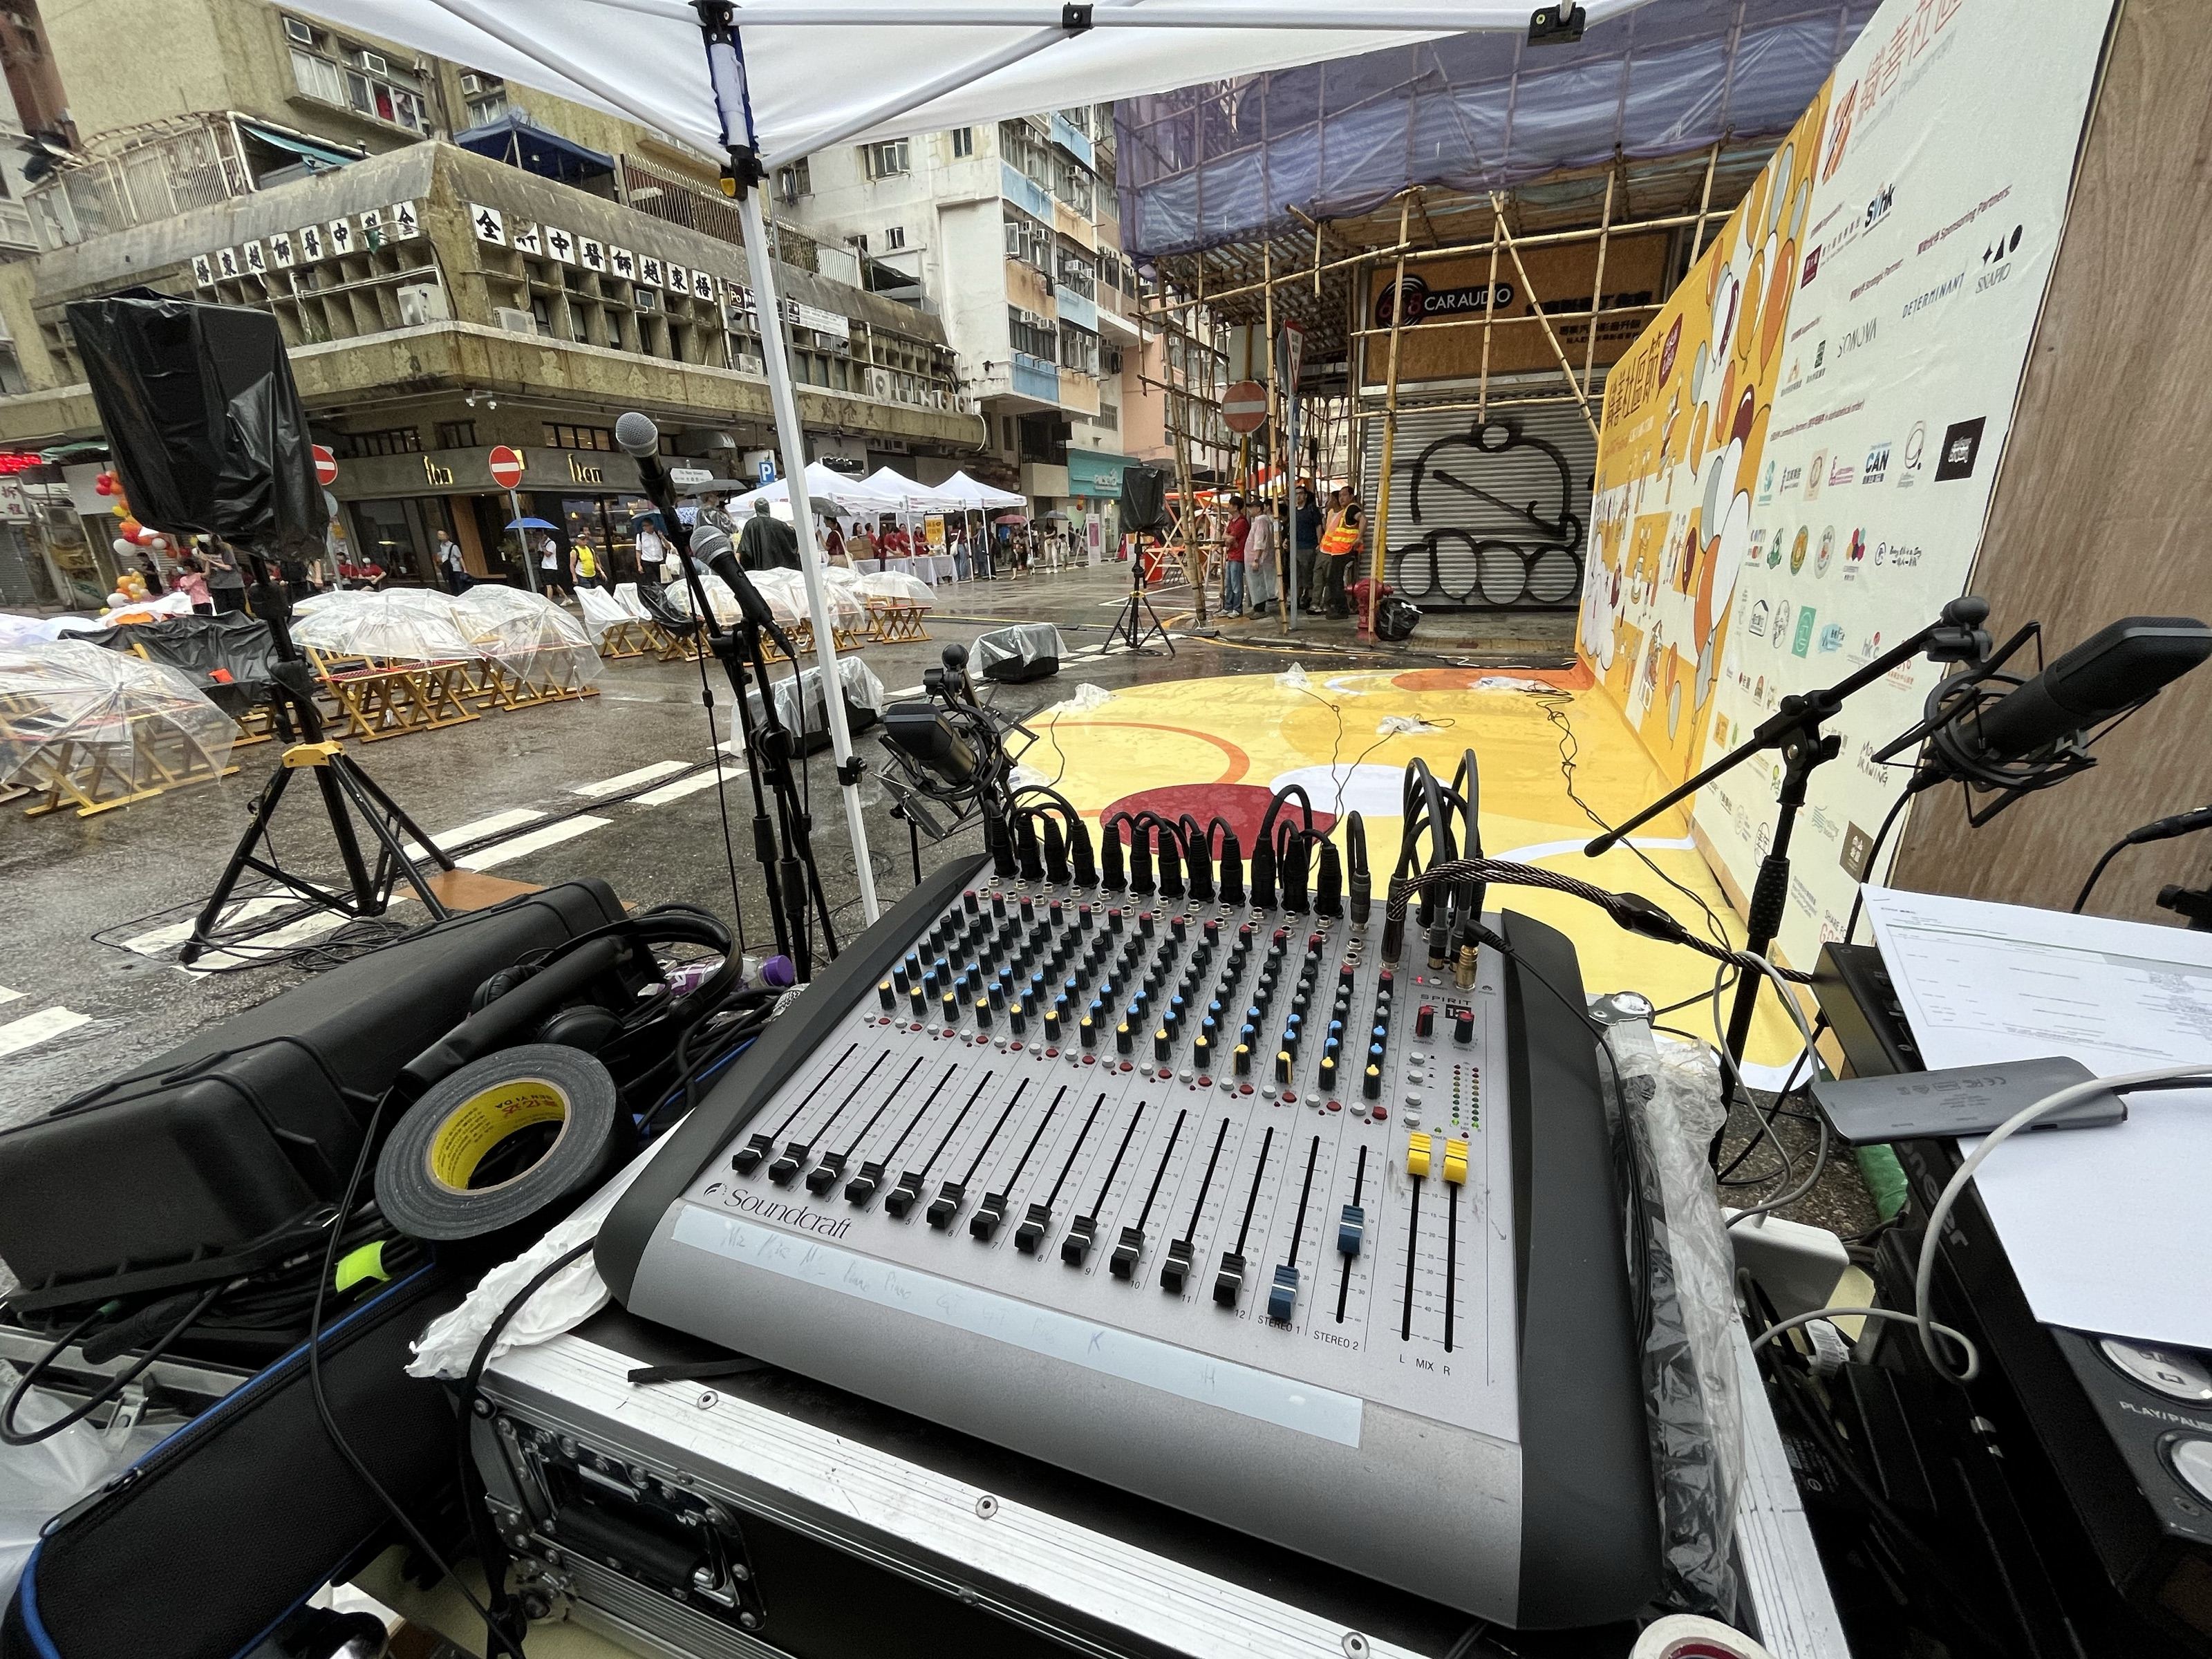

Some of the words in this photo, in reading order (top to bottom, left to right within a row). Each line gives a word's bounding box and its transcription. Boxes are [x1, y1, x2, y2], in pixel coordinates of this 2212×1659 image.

[1902, 272, 1965, 319] DETERMINANT
[1380, 293, 1421, 318] 68
[1425, 293, 1459, 311] CAR
[1866, 450, 1890, 474] CAN
[761, 464, 771, 480] P
[1421, 994, 1471, 1006] SPIRIT
[723, 1188, 852, 1239] Soundcraft
[947, 1229, 953, 1237] 6
[1037, 1255, 1044, 1263] 8
[1085, 1267, 1091, 1276] 9
[1131, 1280, 1140, 1290] 10
[1181, 1294, 1191, 1304] 11
[1234, 1309, 1246, 1319] 12
[1257, 1315, 1293, 1333] STEREO
[1313, 1330, 1350, 1349] STEREO
[1352, 1341, 1359, 1351] 2
[1399, 1353, 1405, 1364] L
[1415, 1358, 1434, 1372] MIX
[1443, 1365, 1451, 1376] R
